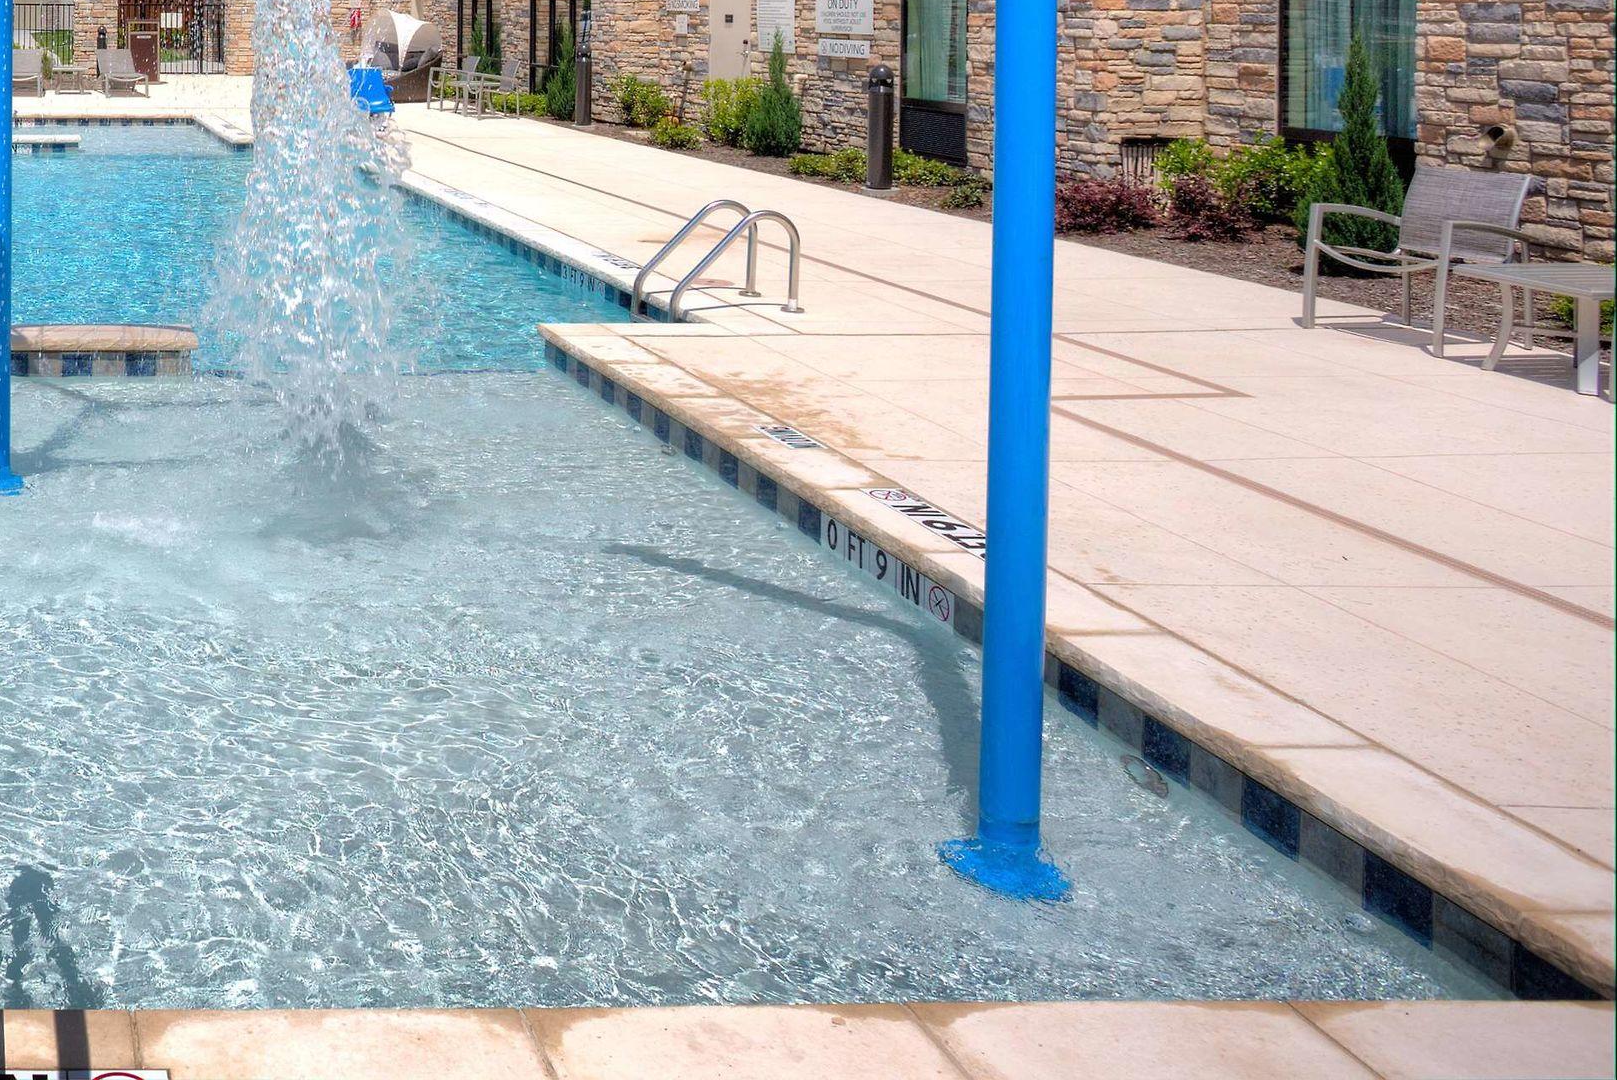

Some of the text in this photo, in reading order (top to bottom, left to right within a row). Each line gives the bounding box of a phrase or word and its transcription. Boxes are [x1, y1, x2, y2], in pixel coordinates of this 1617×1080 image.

[829, 42, 865, 56] NO DIVING
[890, 504, 949, 518] IN
[847, 529, 866, 569] FT
[875, 549, 888, 580] 9
[900, 563, 920, 606] IN
